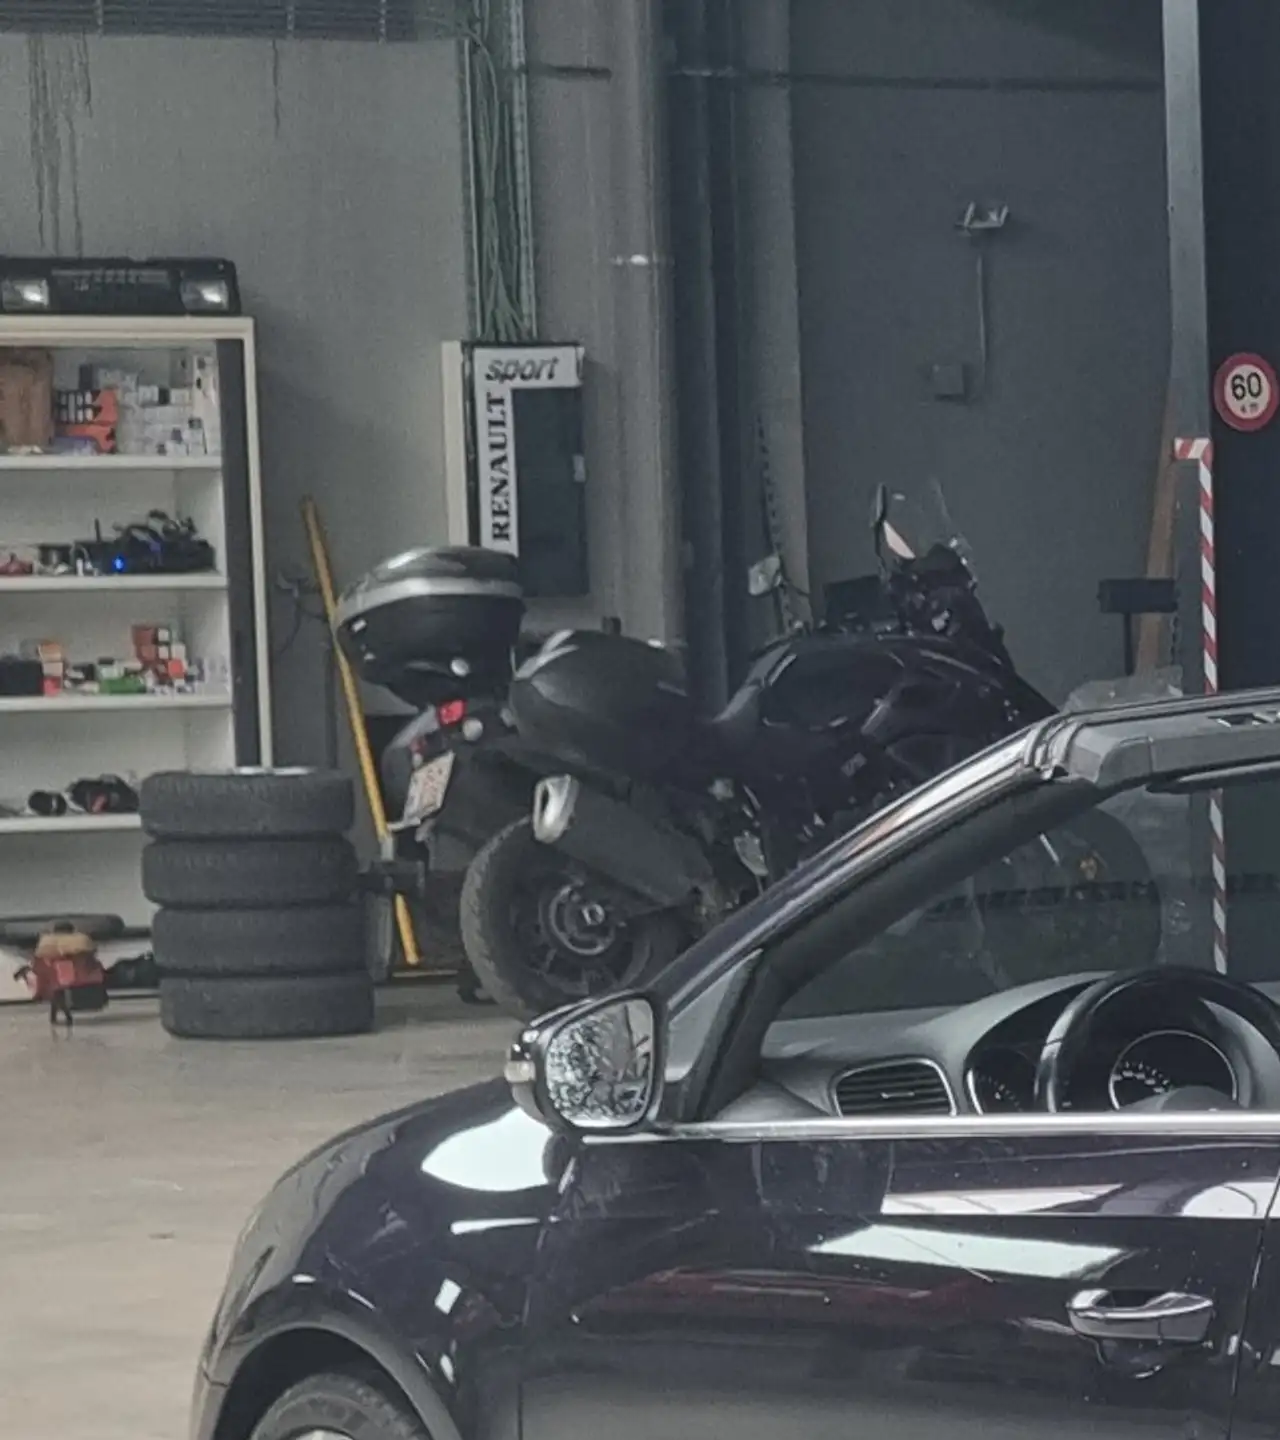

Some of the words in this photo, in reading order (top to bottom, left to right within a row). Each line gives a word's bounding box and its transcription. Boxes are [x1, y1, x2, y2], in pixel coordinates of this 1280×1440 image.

[485, 356, 560, 384] sport
[1231, 371, 1263, 401] 60
[486, 391, 511, 542] RENAULT
